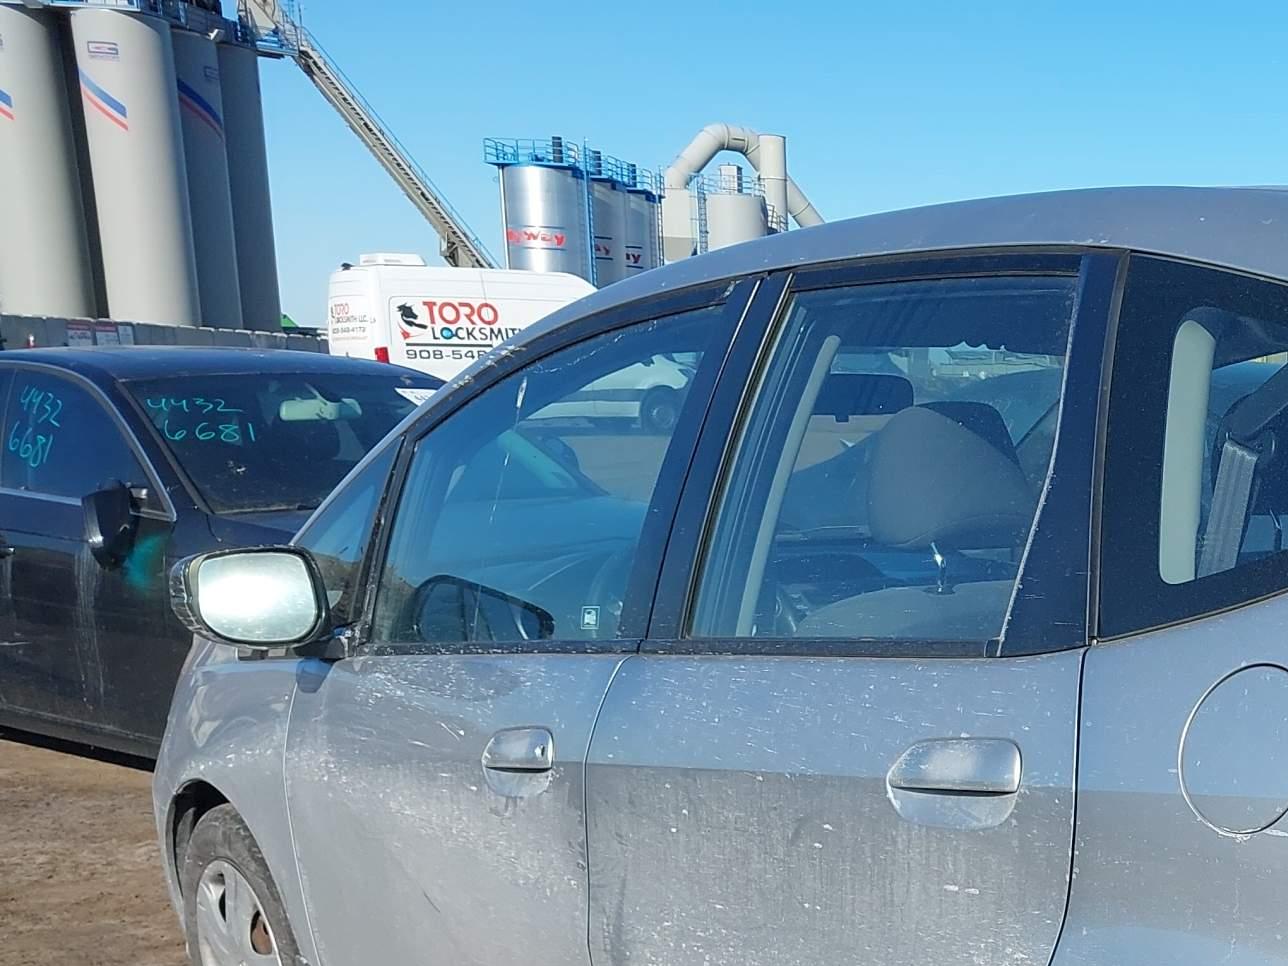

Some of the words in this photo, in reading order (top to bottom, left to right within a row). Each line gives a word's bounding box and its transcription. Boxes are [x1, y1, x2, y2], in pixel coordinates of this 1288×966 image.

[422, 300, 499, 326] TORO
[431, 326, 522, 342] LOCKSMIT
[20, 384, 63, 428] 4432
[146, 397, 244, 414] 4432
[163, 418, 257, 443] 6681
[8, 420, 54, 468] 6681
